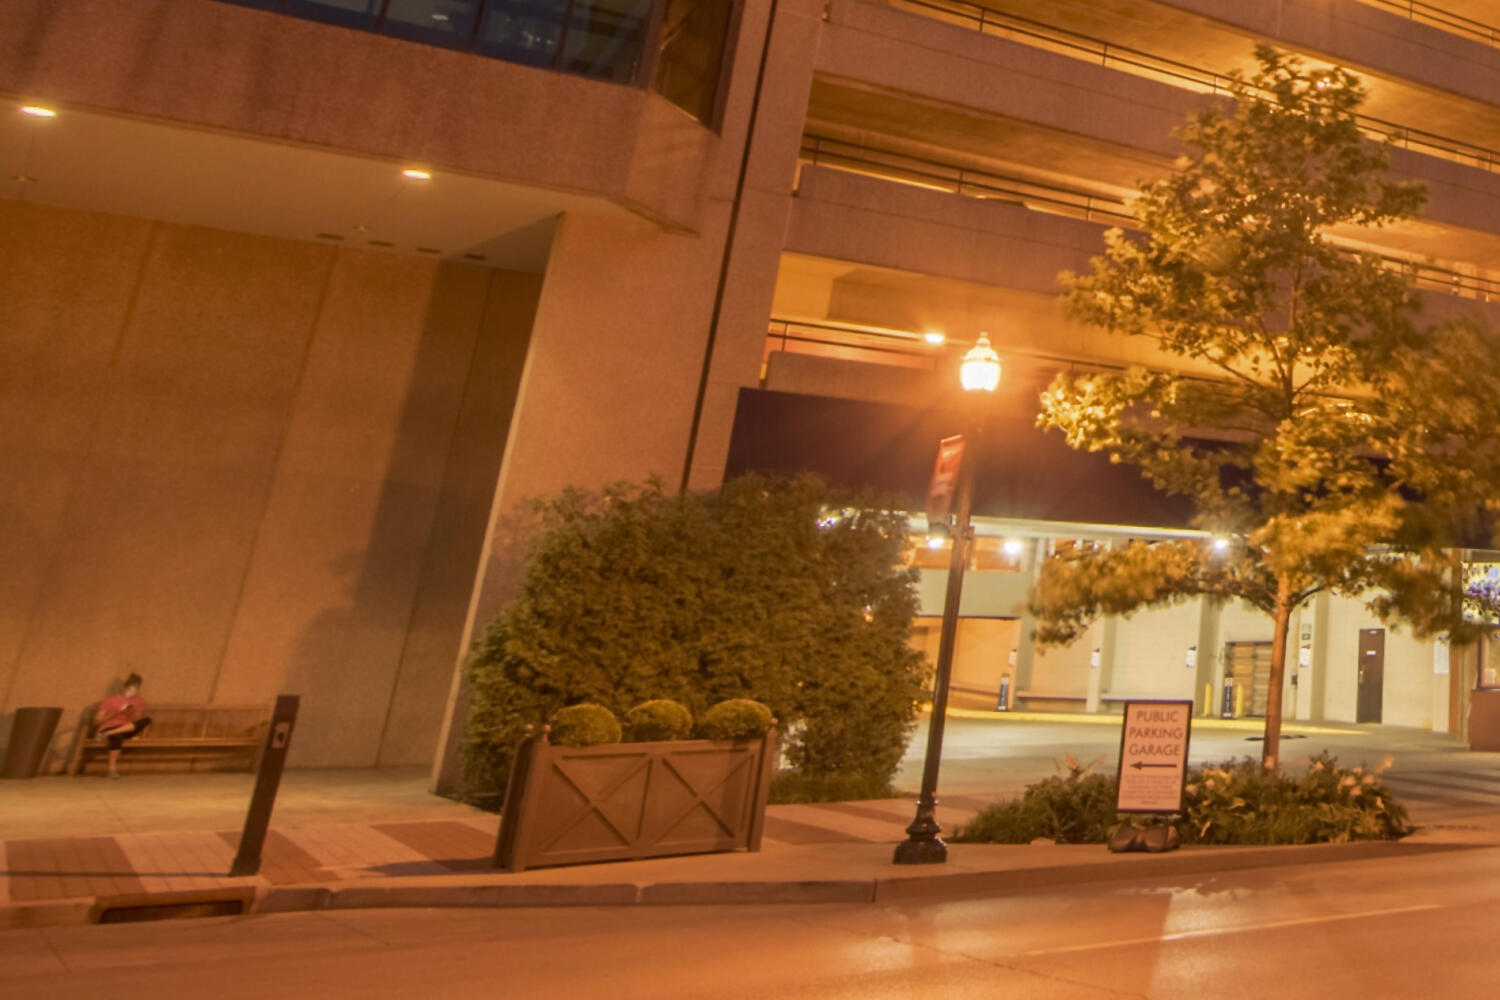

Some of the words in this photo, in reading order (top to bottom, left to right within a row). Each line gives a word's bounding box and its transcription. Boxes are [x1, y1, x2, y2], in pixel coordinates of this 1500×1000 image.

[1136, 710, 1179, 722] PUBLIC
[1128, 727, 1184, 740] PARKING
[1128, 744, 1181, 756] GARAGE
